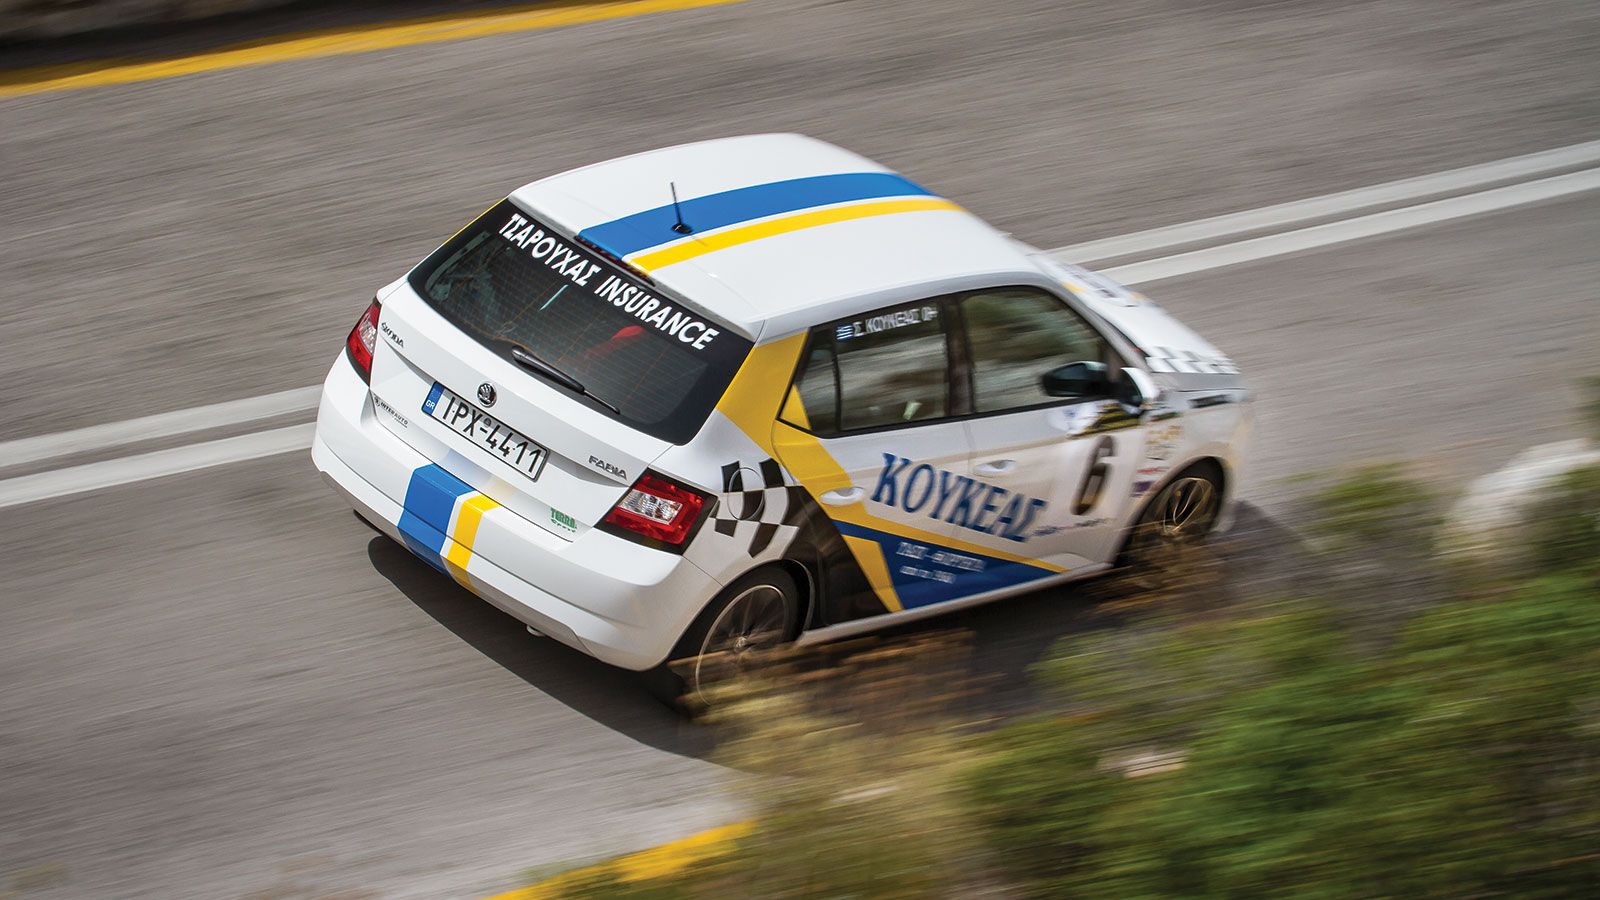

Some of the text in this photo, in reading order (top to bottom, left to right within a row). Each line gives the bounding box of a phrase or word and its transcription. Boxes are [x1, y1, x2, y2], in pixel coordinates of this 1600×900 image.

[498, 213, 720, 350] ΤΣΑΡΟΥΧΑΣ INSURANCE
[425, 400, 436, 410] GR
[588, 455, 627, 480] FABIA
[870, 452, 1048, 543] ΚΟΥΚΕΑΣ
[1070, 434, 1116, 515] 6
